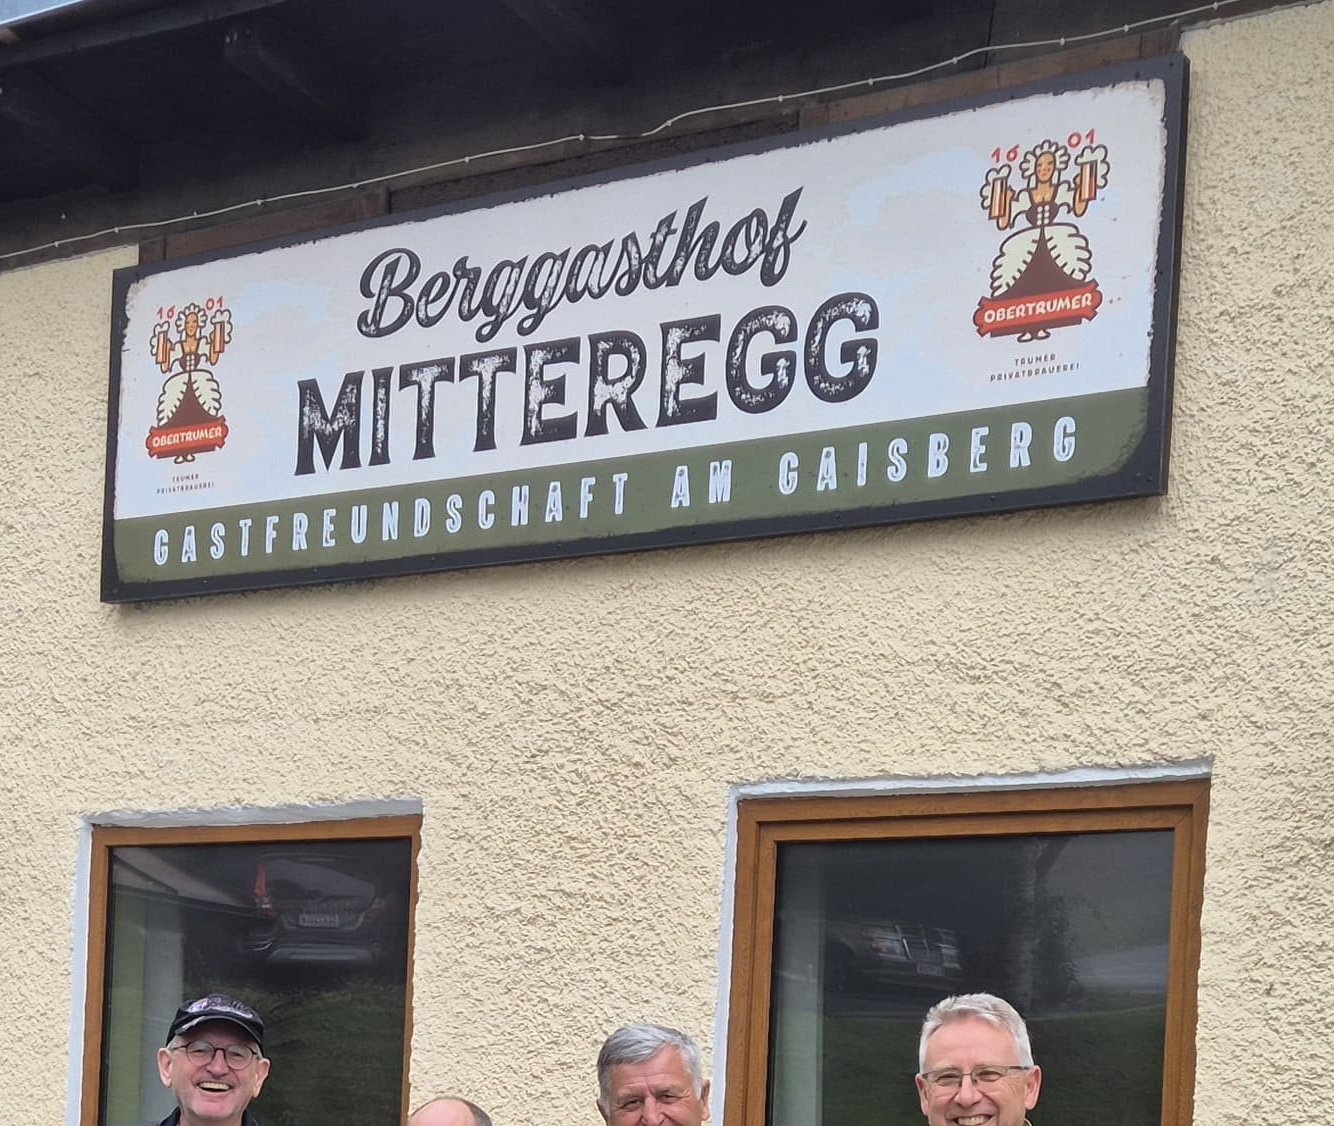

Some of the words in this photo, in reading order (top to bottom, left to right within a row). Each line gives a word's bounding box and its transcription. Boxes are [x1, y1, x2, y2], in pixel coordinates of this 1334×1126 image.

[991, 144, 1020, 164] 16
[1067, 128, 1096, 149] 01
[355, 185, 809, 344] Berggasthof
[983, 292, 1094, 323] OBERTRUMER
[989, 362, 1080, 382] PRIVATBRAUEREI
[1014, 353, 1056, 367] TRUMER
[294, 290, 880, 477] MITTEREGG
[152, 425, 224, 448] OBERTRUMER
[153, 472, 629, 566] GASTFREUNDSCHAFT
[670, 459, 733, 509] AM
[778, 415, 1077, 496] GAISBERG
